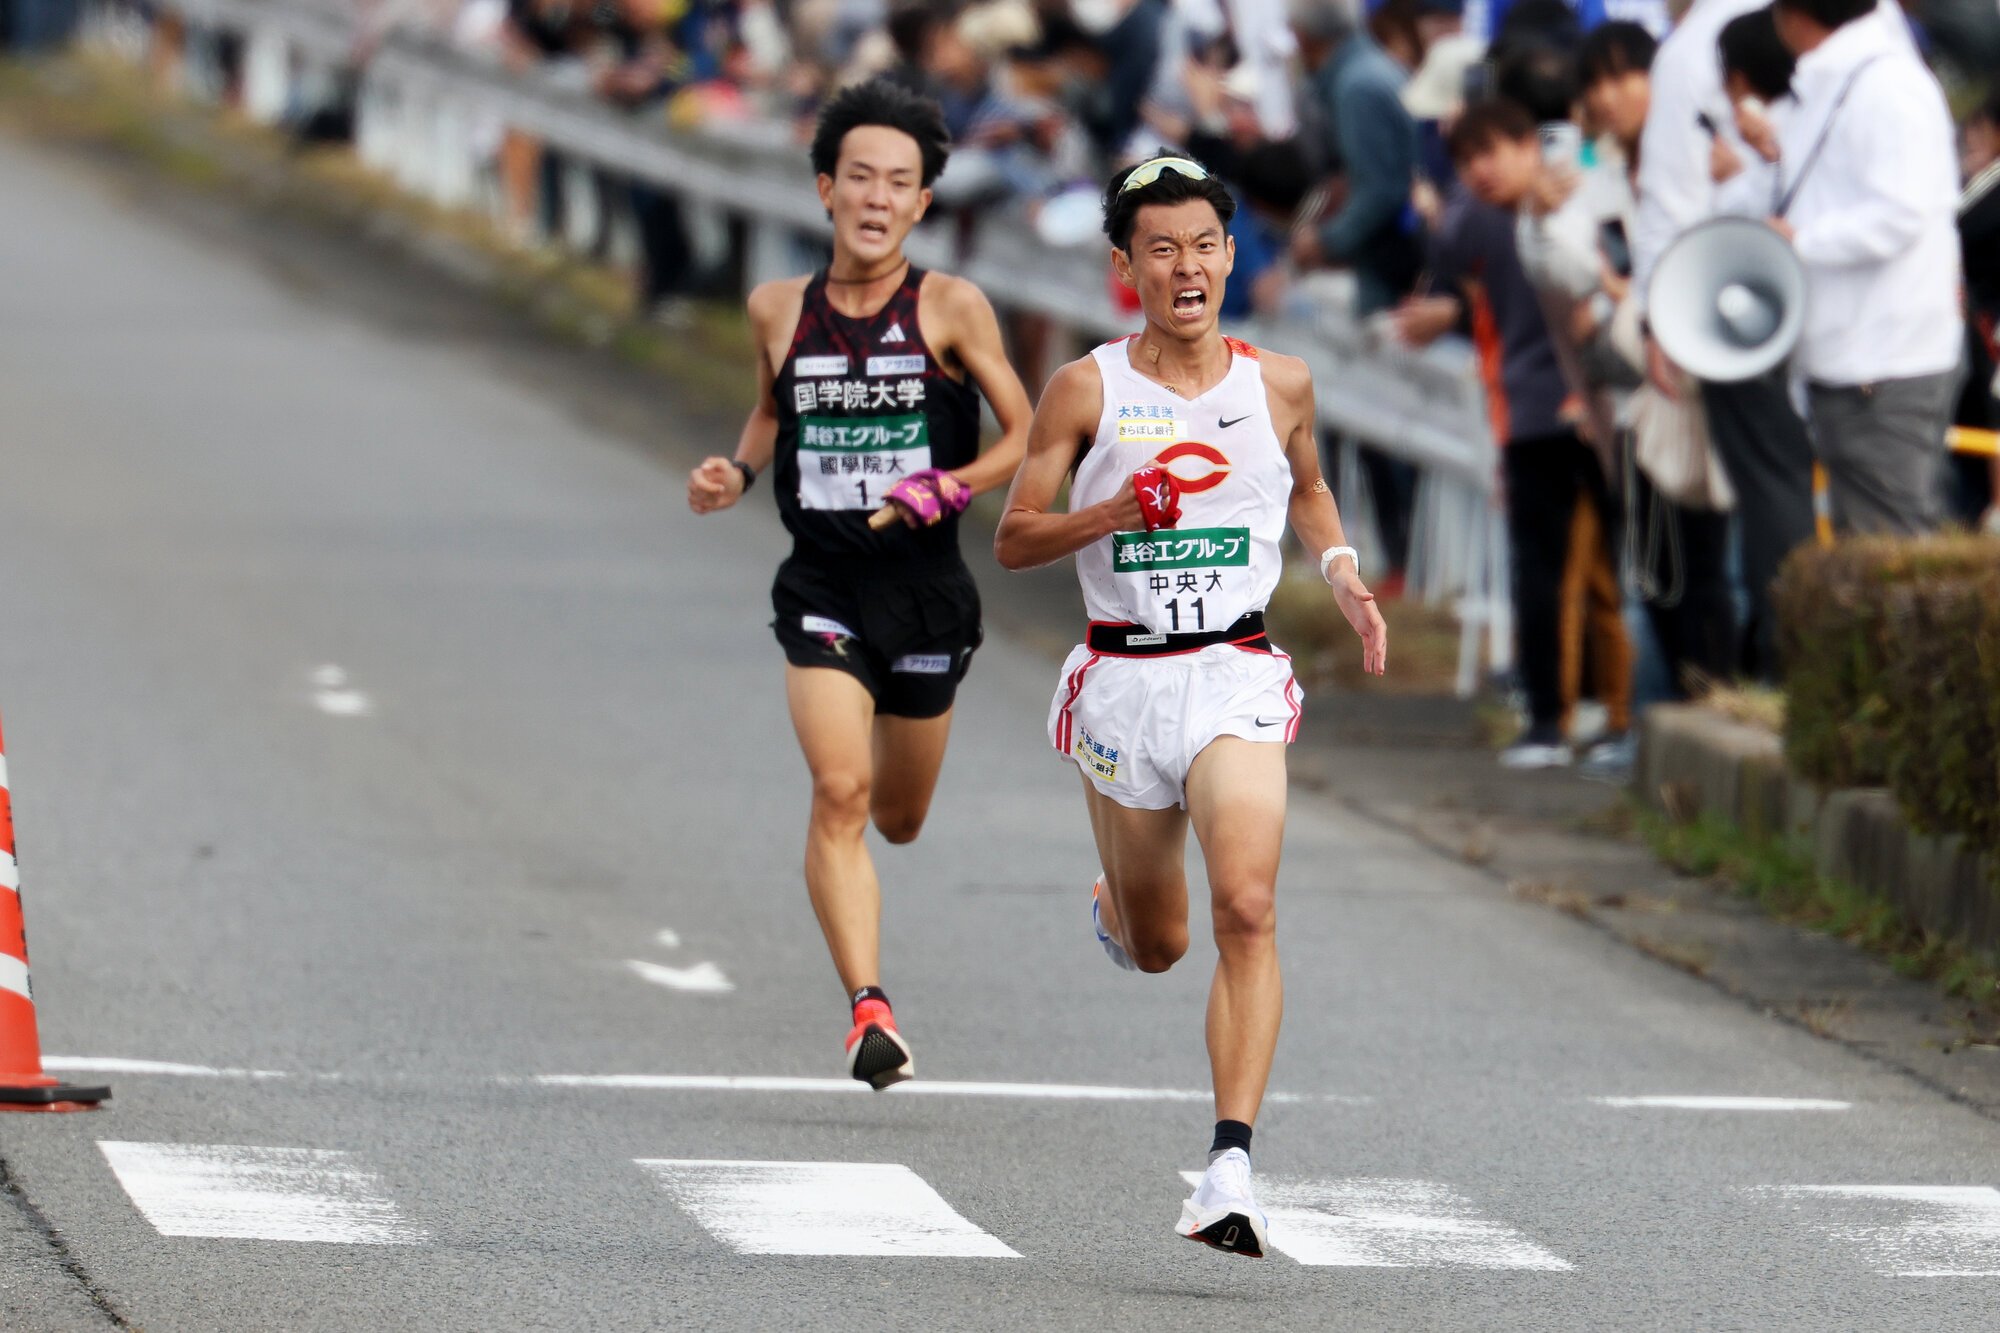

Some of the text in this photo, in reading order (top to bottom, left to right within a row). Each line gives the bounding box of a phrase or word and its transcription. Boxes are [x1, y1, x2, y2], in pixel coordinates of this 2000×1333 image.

[794, 379, 926, 413] 国学院大学
[1118, 405, 1175, 419] 大矢運送
[804, 421, 922, 447] 長谷工グループ
[1119, 425, 1174, 436] きらぼし銀行
[820, 455, 904, 475] 國學院大
[855, 479, 868, 506] 1
[1118, 536, 1245, 564] 長谷工グループ
[1150, 569, 1223, 596] 中央大
[1165, 597, 1205, 631] 11
